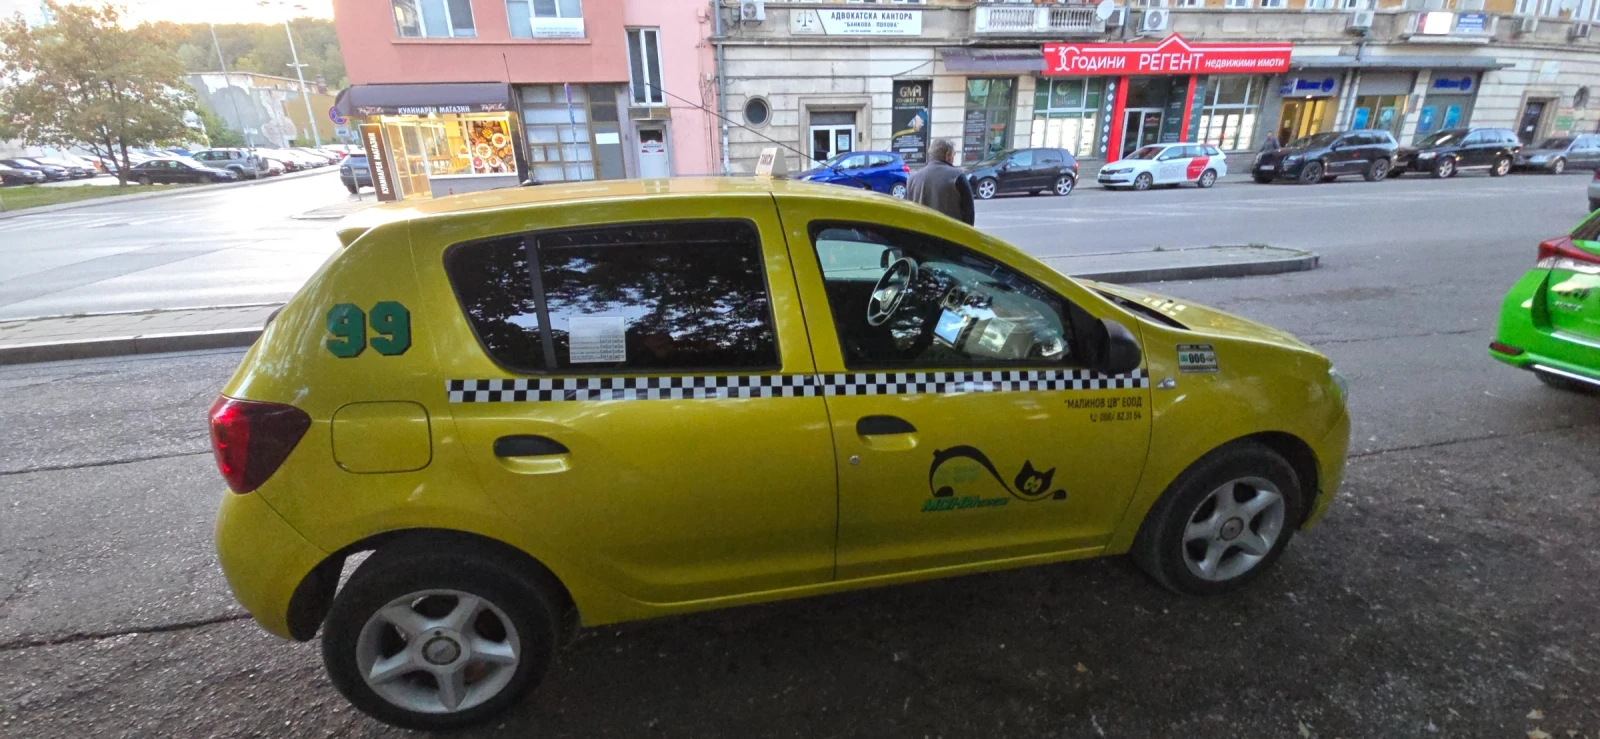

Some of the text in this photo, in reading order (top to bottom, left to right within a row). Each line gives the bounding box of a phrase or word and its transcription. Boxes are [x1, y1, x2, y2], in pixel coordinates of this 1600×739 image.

[831, 12, 878, 20] АДВОКАТСКА
[1072, 56, 1126, 71] ГОДИНИ
[1138, 53, 1204, 71] РЕГЕНТ
[439, 105, 470, 113] МАГАЗИН
[367, 132, 381, 160] МАГАЗИН
[374, 161, 389, 194] КУЛИНАРЕН
[326, 301, 412, 359] 99
[1188, 353, 1206, 364] 006
[1064, 397, 1106, 409] "МАЛИНОВ
[1122, 396, 1142, 408] ЕООД
